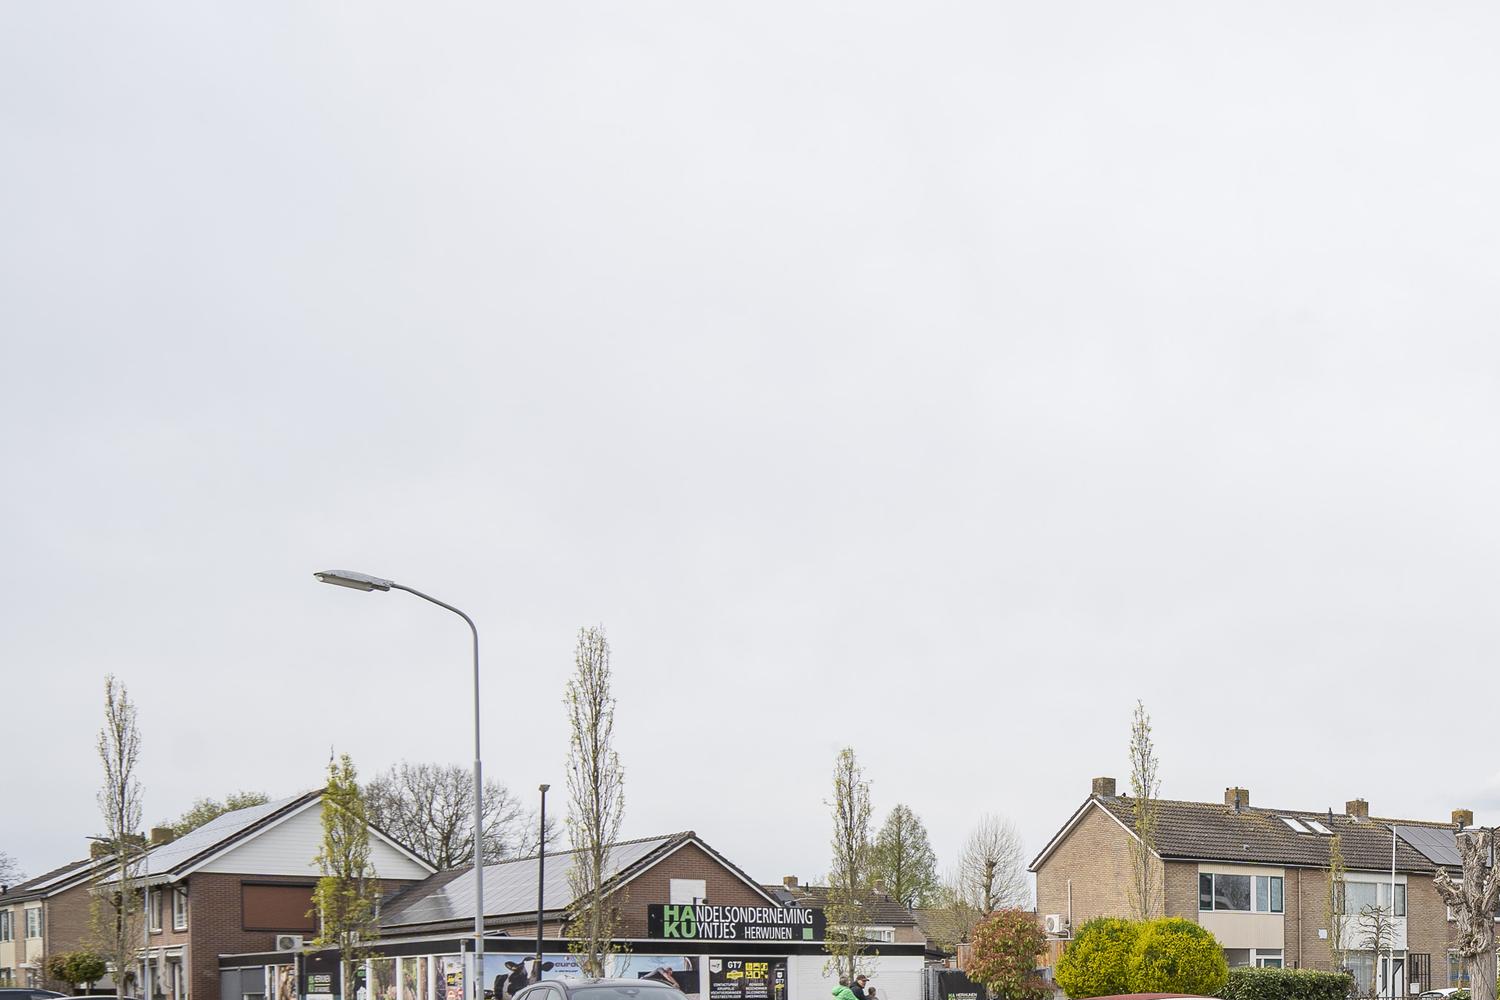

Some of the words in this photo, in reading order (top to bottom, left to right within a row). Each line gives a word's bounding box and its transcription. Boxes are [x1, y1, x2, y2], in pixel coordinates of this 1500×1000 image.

[663, 904, 813, 925] HANDELSONDERNEMING
[663, 921, 736, 939] KUYNTJES
[744, 926, 793, 940] HERWIJNEN
[727, 961, 742, 969] GT7
